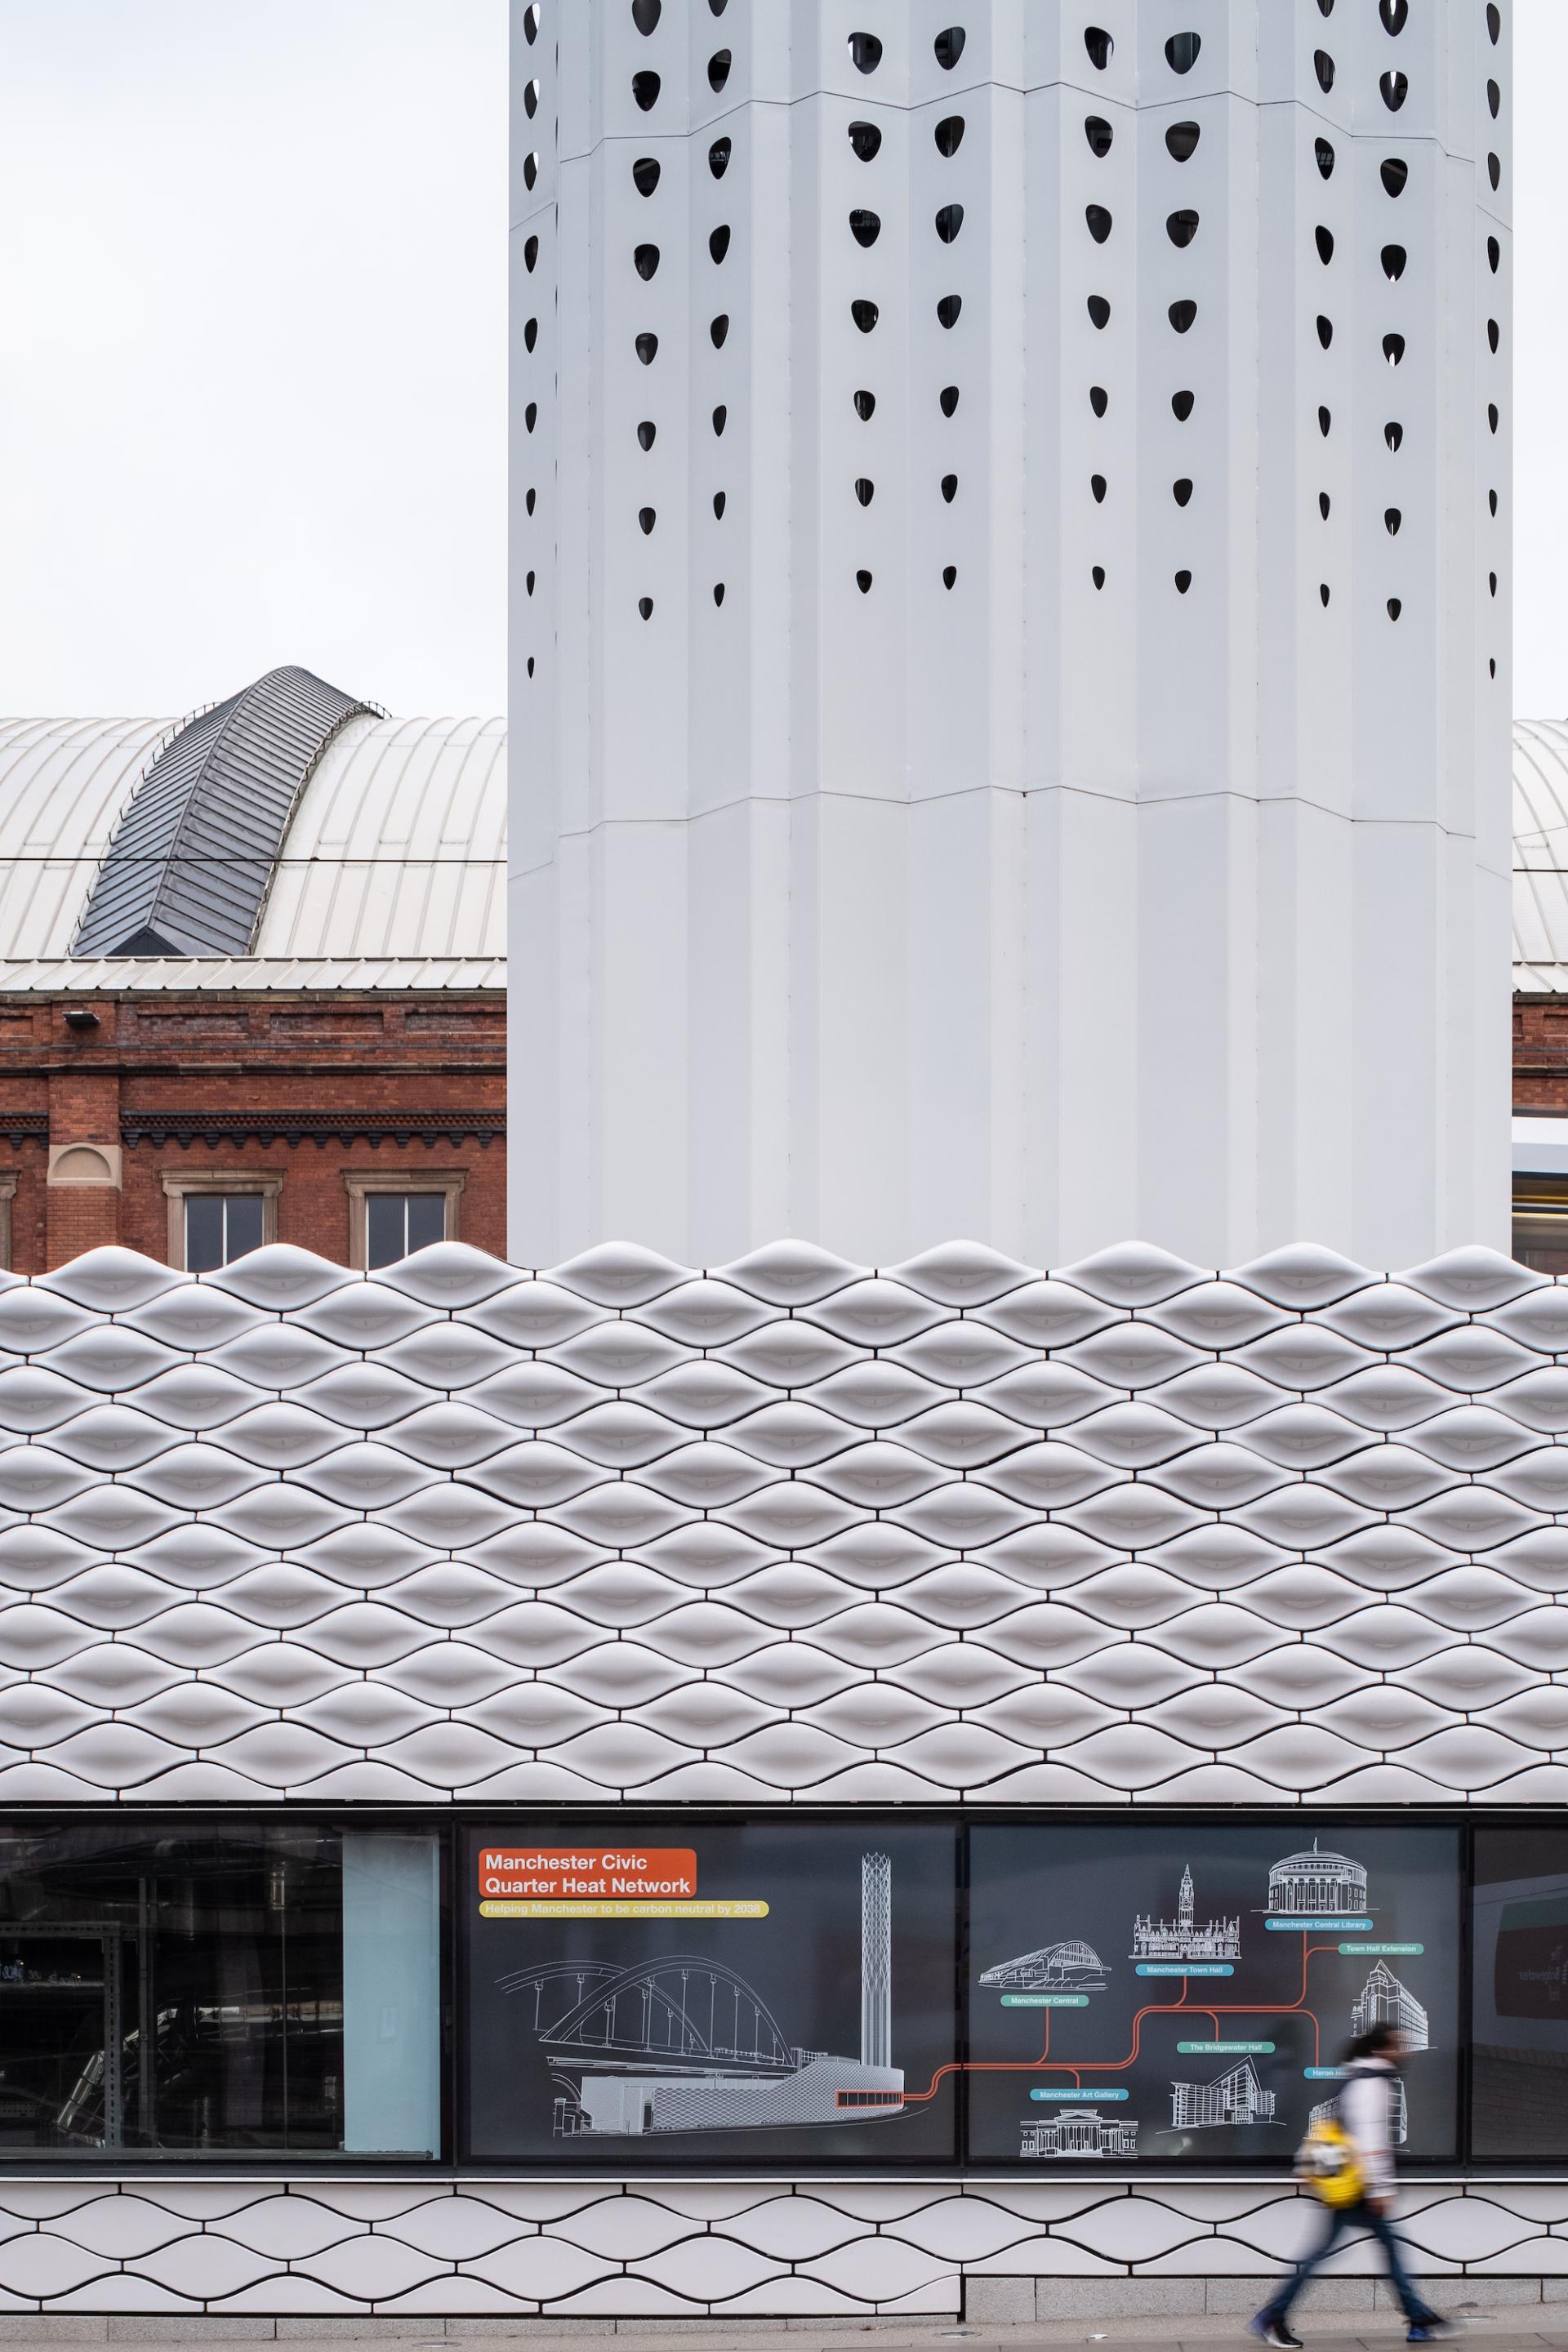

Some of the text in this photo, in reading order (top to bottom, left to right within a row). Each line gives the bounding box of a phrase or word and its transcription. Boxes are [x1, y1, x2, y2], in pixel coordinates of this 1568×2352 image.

[485, 1854, 648, 1869] Manchester Civic
[485, 1878, 690, 1894] Quarter Heat Network
[485, 1904, 760, 1915] Helping Manchester to be carbon neutral by 2038
[1342, 1921, 1366, 1930] Library
[1205, 2044, 1247, 2052] Bridgewater
[1094, 2091, 1119, 2100] Gallery
